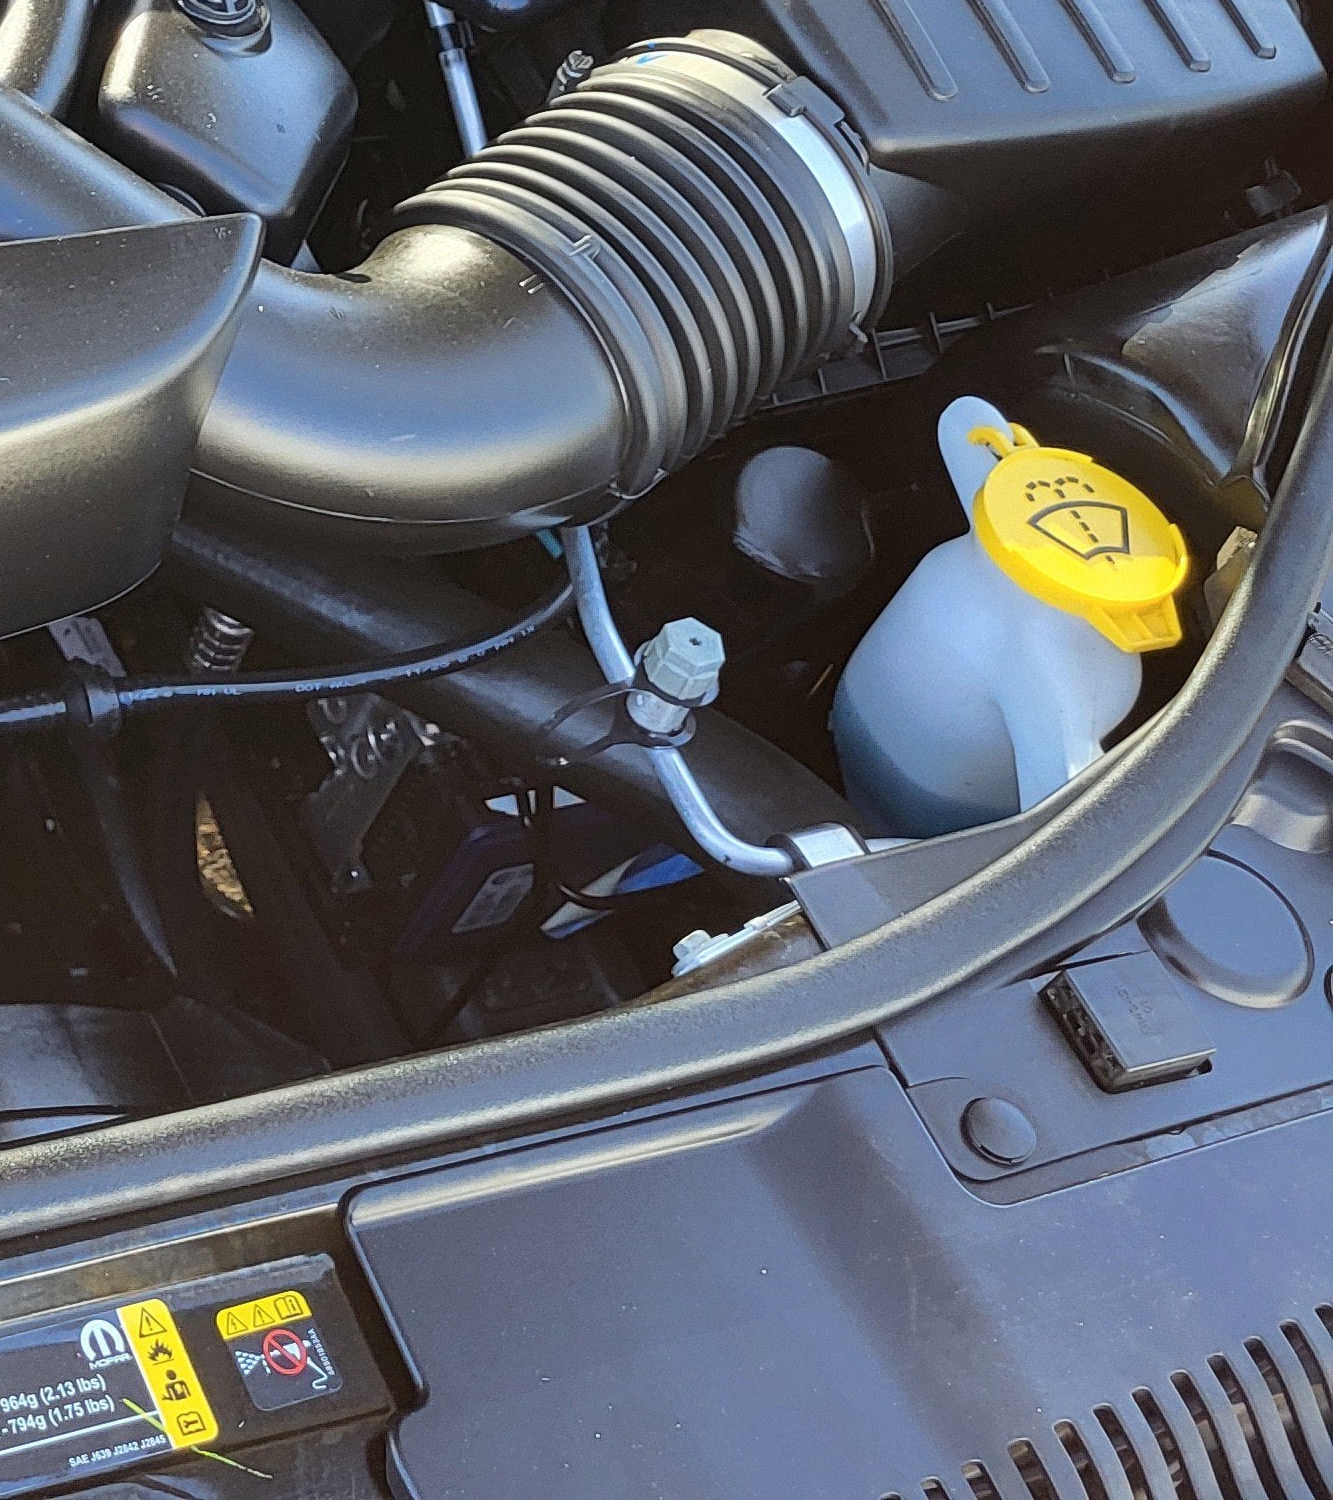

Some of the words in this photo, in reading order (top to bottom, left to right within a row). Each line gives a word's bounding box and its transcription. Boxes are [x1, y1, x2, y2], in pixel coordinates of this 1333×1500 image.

[89, 1353, 132, 1370] MOPAR
[40, 1380, 76, 1407] (2.13
[77, 1373, 107, 1394] lbs)
[49, 1402, 84, 1427] (1.75
[85, 1394, 115, 1414] lbs)
[69, 1453, 88, 1468] SAE
[91, 1447, 111, 1463] J639
[113, 1441, 140, 1457] J2842
